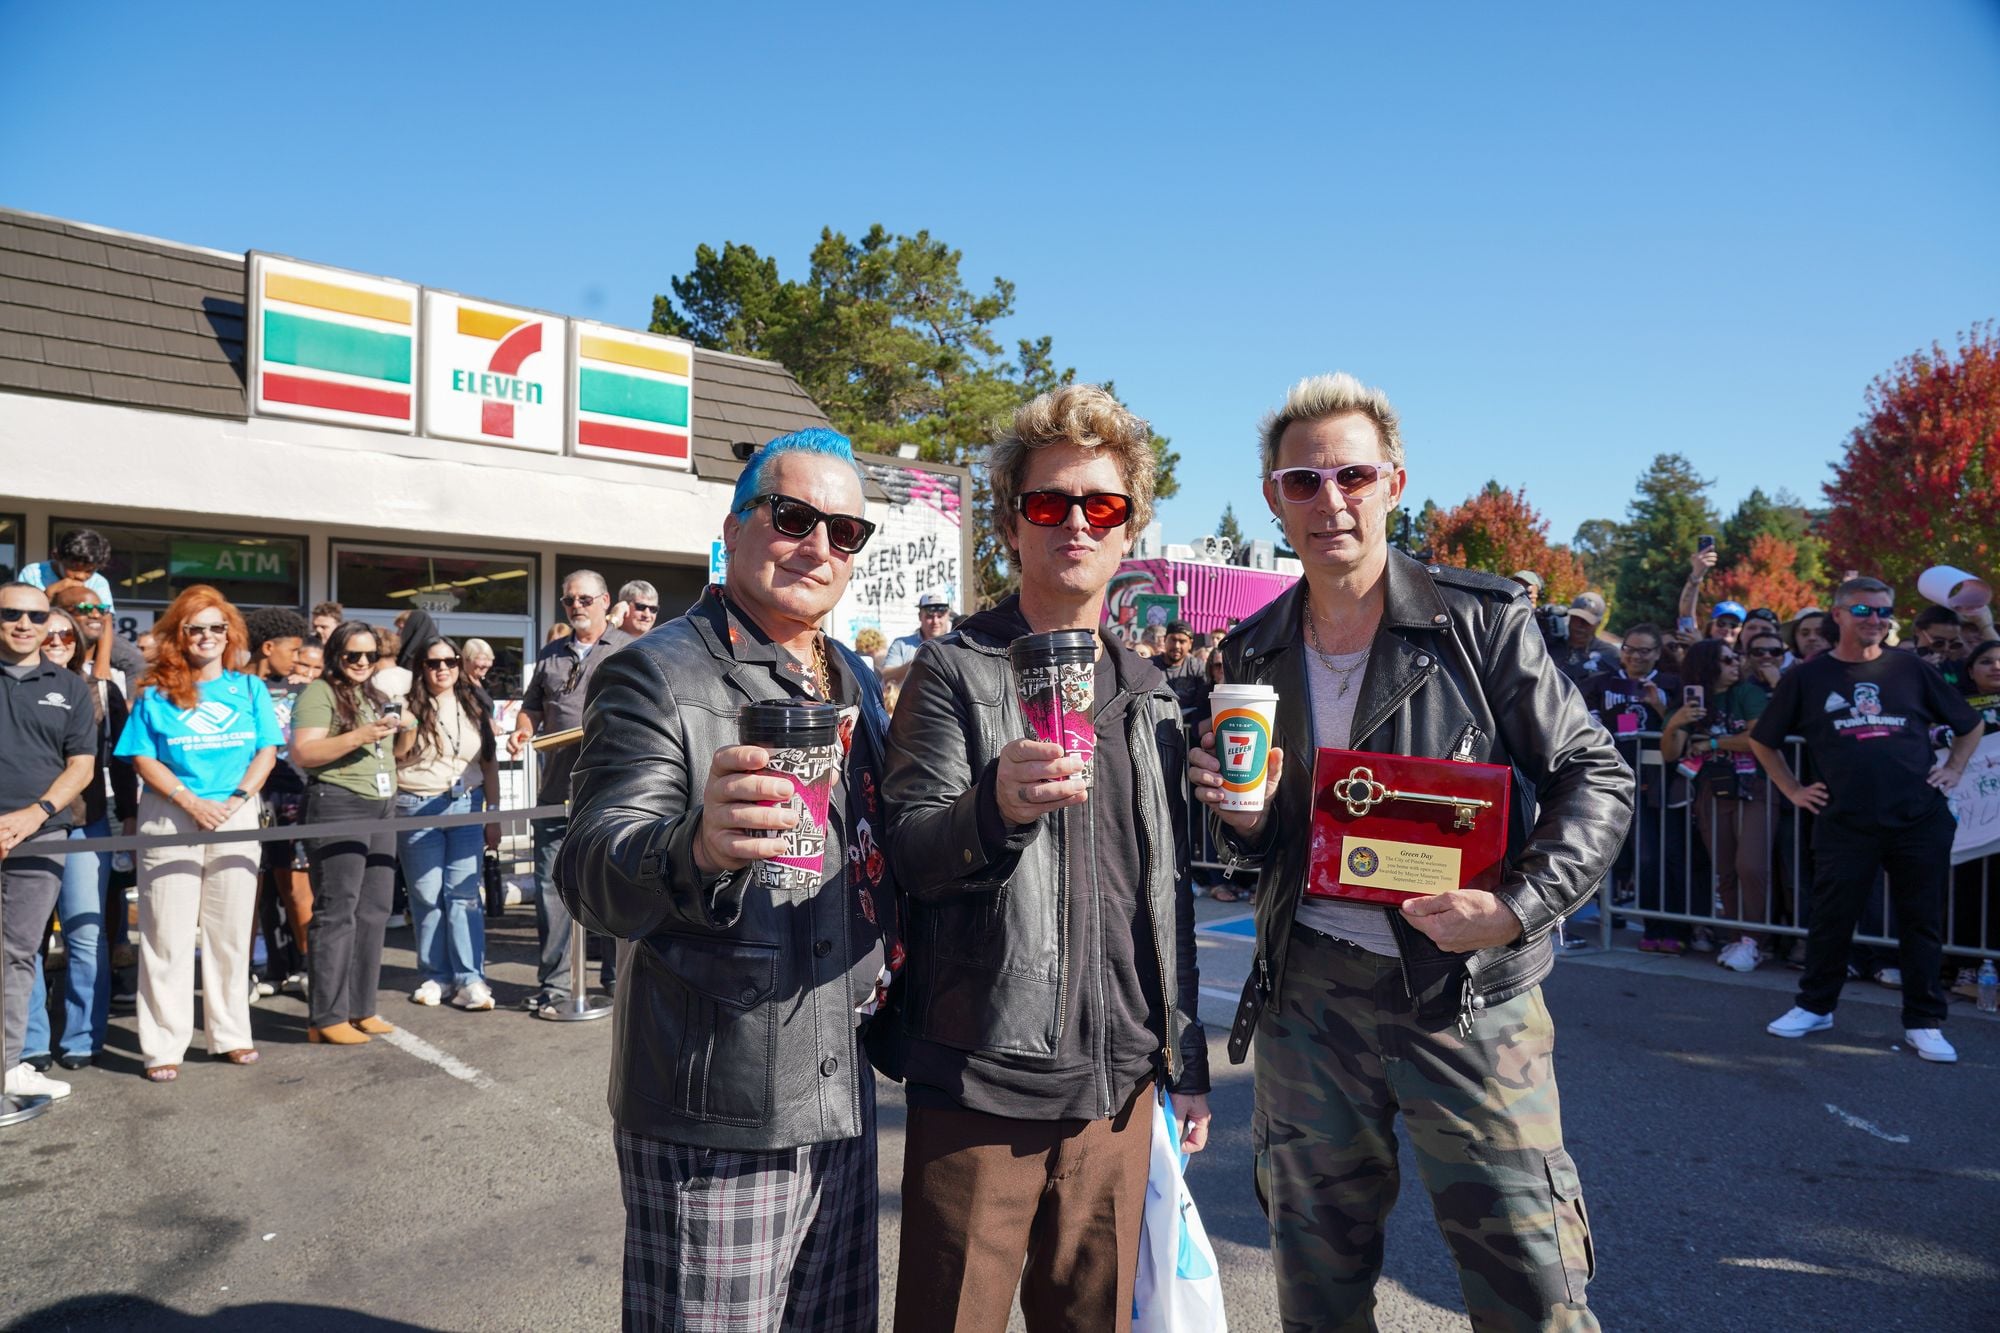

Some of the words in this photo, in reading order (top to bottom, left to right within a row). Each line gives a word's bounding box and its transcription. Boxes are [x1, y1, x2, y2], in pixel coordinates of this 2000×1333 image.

[457, 306, 543, 438] 7
[215, 550, 280, 575] ATM
[852, 544, 902, 580] REEN
[907, 533, 938, 565] DAY
[864, 574, 906, 606] WAS
[915, 558, 957, 593] HERE
[1229, 735, 1250, 765] 7
[1401, 850, 1419, 858] Green
[1420, 852, 1433, 860] Day
